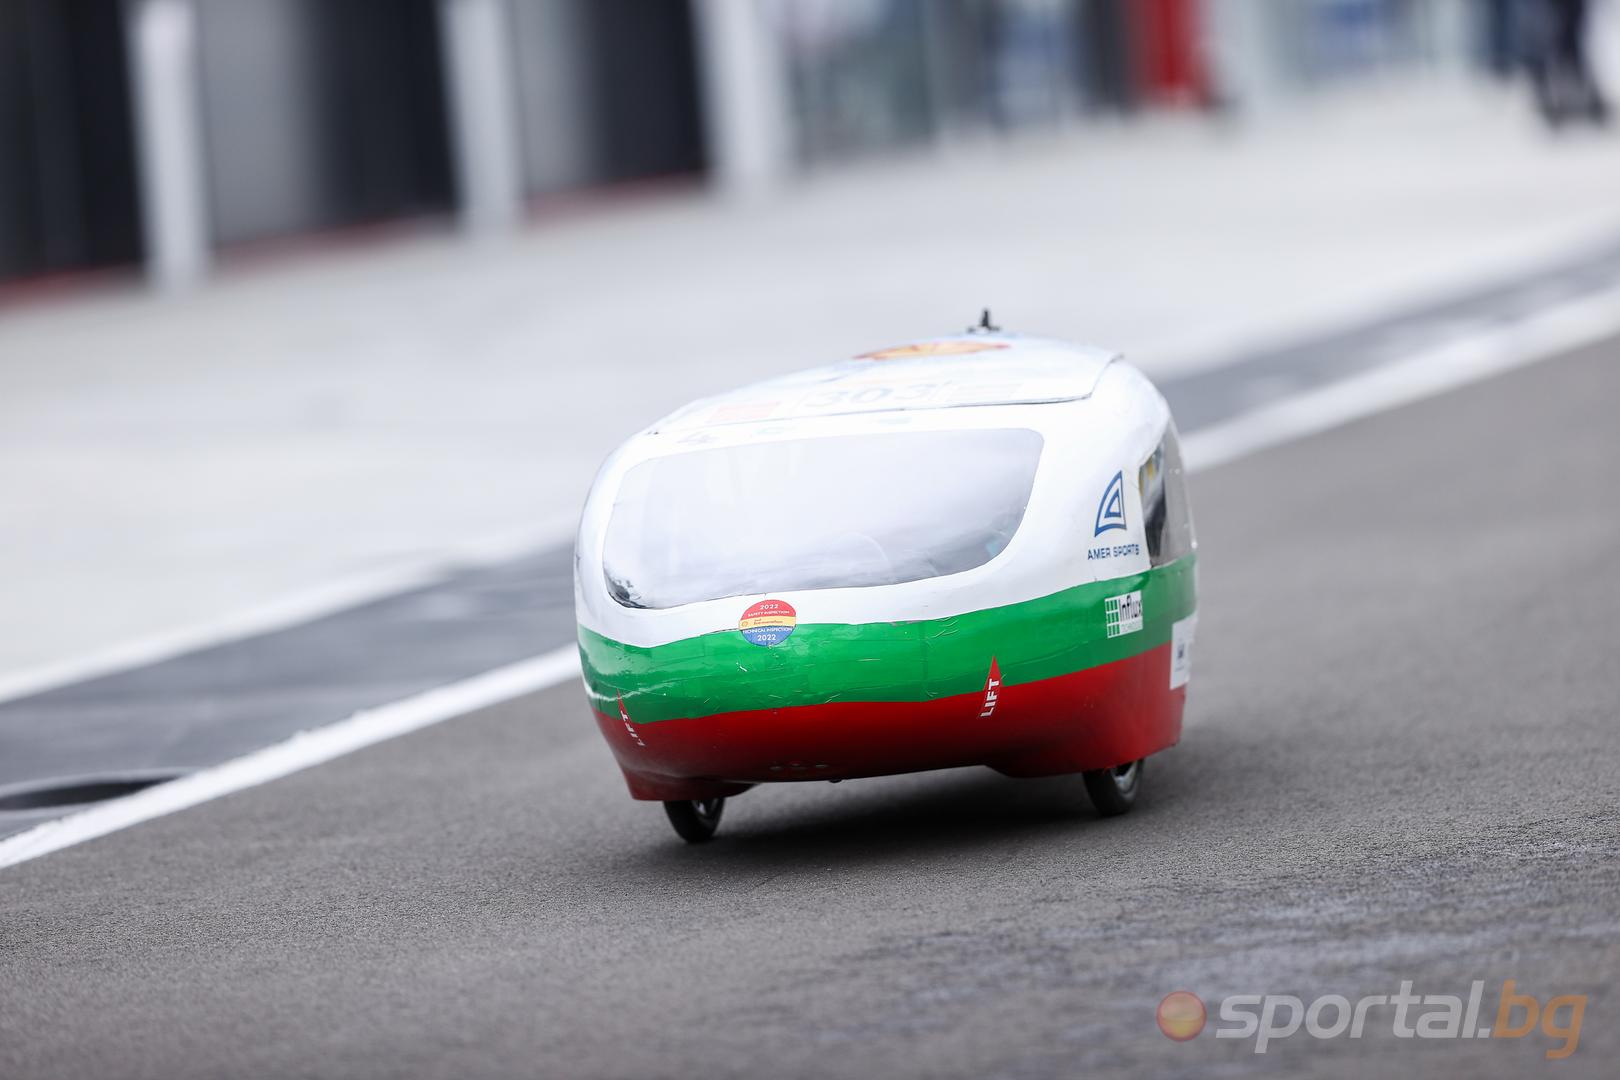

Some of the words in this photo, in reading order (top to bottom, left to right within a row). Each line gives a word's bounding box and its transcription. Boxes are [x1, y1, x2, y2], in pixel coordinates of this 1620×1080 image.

[803, 383, 938, 407] 303
[1087, 547, 1111, 560] AMER
[1113, 544, 1140, 558] SPORTS
[757, 633, 777, 641] 2022
[980, 678, 1000, 717] LIFT
